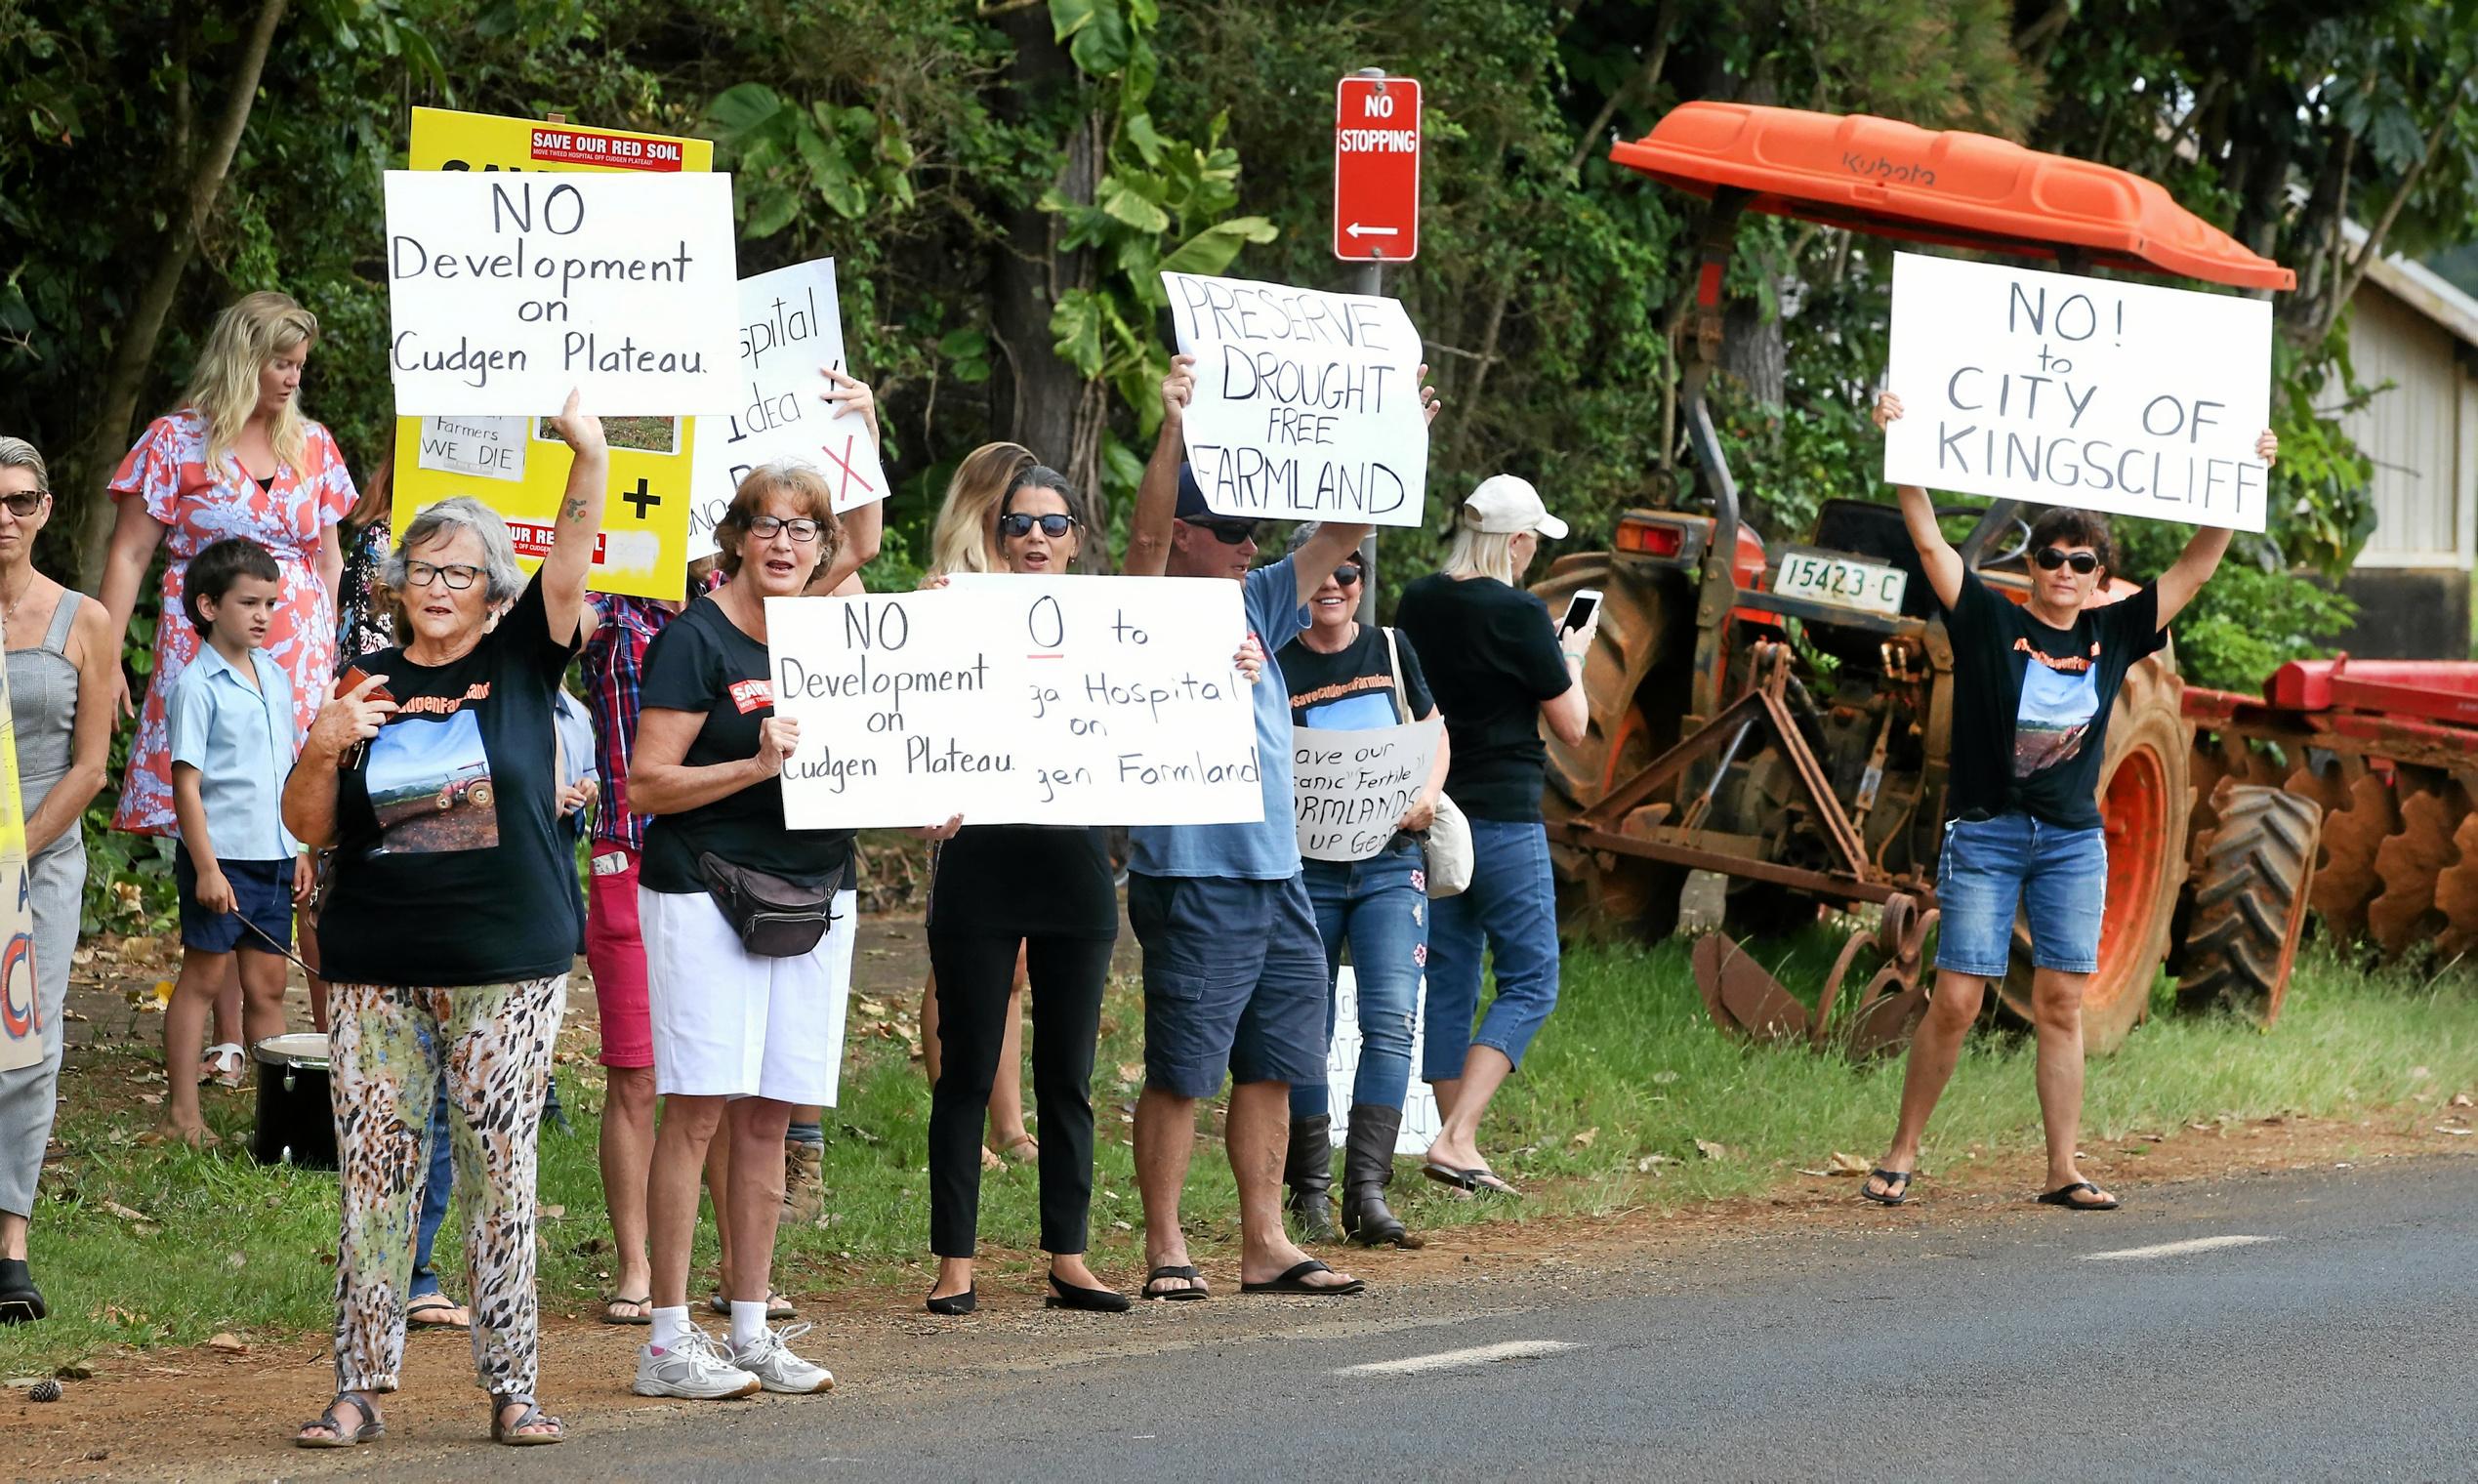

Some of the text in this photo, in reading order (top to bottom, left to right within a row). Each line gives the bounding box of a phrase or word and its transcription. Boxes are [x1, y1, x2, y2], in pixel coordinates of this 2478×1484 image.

[1365, 95, 1393, 118] NO
[533, 133, 680, 161] SAVE OUR RED SOIL
[1341, 129, 1416, 152] STOPPING
[1843, 151, 1936, 186] Kubota
[493, 183, 584, 234] NO
[393, 236, 693, 298] Development
[518, 301, 567, 322] on
[1177, 276, 1389, 350] PRESERVE
[394, 331, 707, 388] Cudgen Plateau.
[2038, 344, 2072, 373] to
[1223, 345, 1395, 413] DROUGHT
[1948, 366, 2226, 443] CITY OF
[1267, 407, 1339, 445] FREE
[422, 437, 458, 461] WE
[478, 445, 514, 470] DIE
[1939, 421, 2264, 514] KINGSCLIFF
[1192, 445, 1404, 515] FARMLAND
[509, 527, 531, 542] UR
[845, 601, 908, 650] NO
[1111, 609, 1148, 644] to
[781, 653, 990, 712] Development
[1085, 672, 1238, 723] Hospital
[867, 712, 903, 732] on
[1070, 718, 1108, 736] on
[907, 735, 1015, 773] Plateau.
[1117, 746, 1260, 785] Farmland
[1355, 743, 1394, 763] our
[1295, 786, 1422, 824] RMLANDS
[1310, 834, 1342, 850] UP
